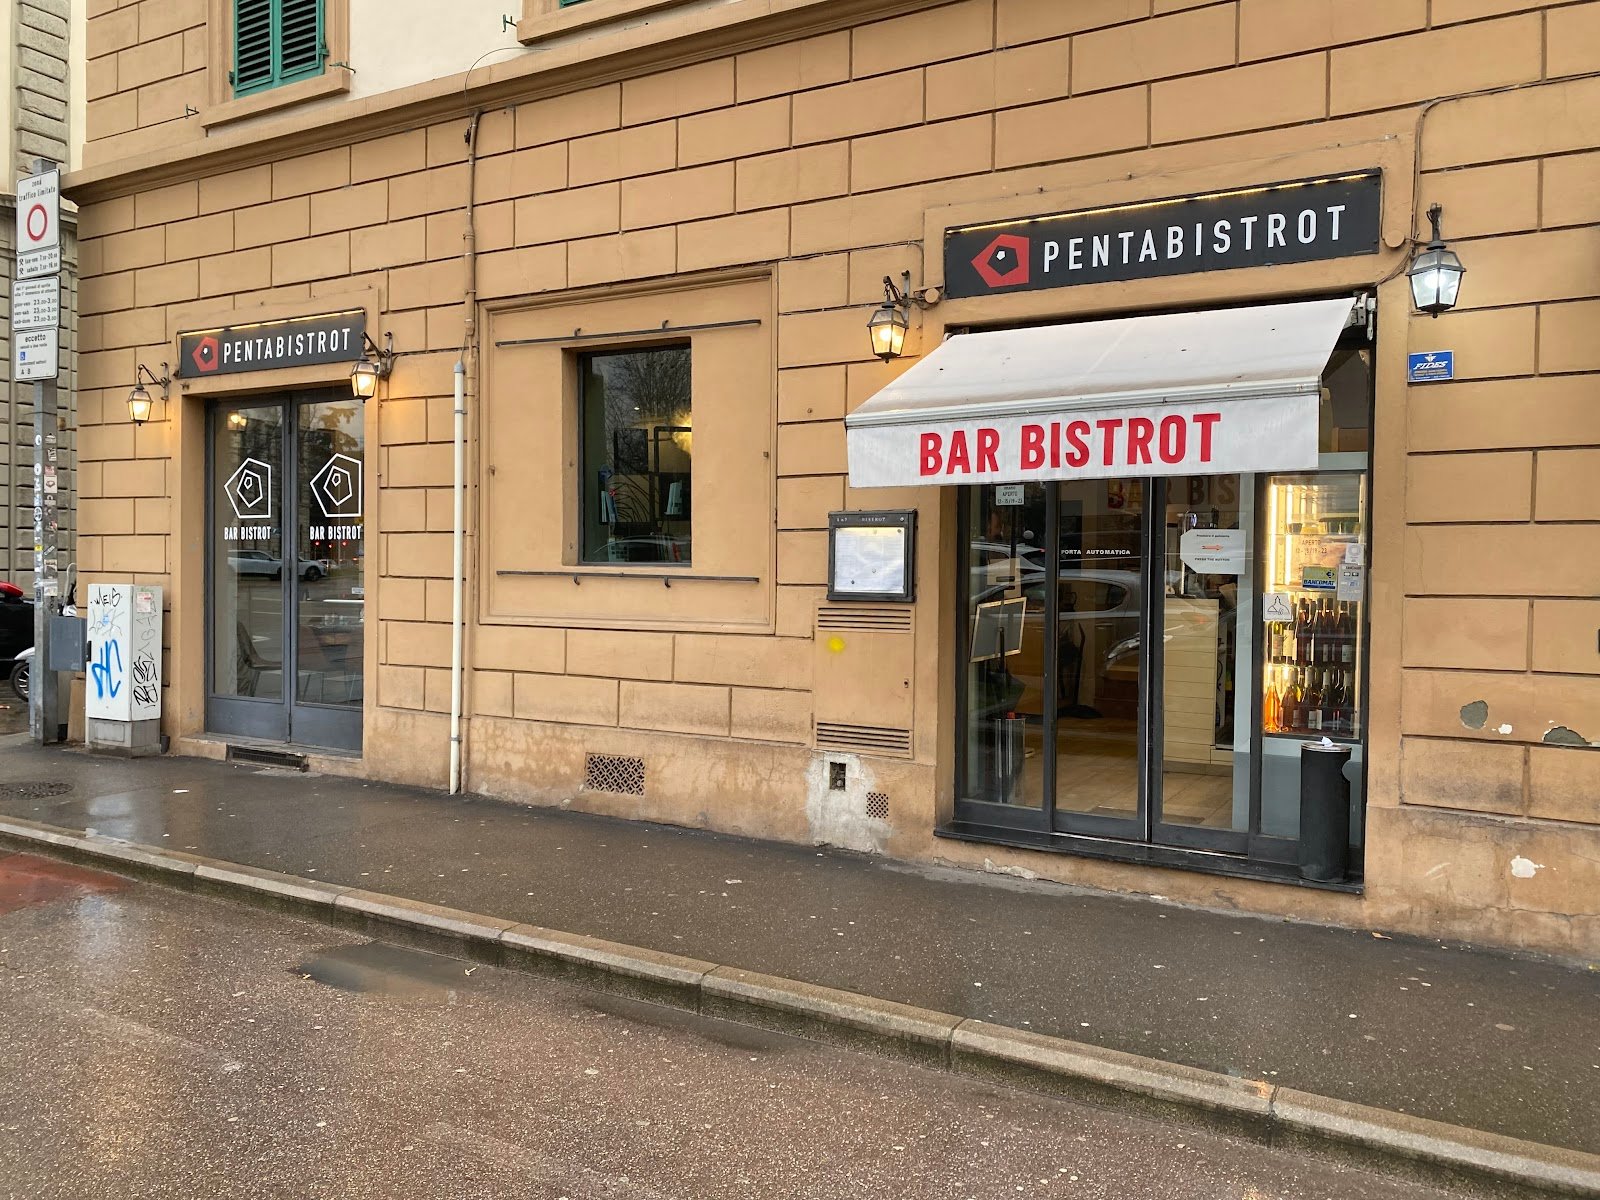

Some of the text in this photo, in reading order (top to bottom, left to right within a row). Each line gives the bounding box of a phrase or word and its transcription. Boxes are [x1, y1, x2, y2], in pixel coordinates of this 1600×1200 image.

[1043, 204, 1346, 273] PENTABISTROT
[25, 333, 46, 343] eccetto
[223, 328, 351, 364] PENTABISTROT
[1413, 361, 1449, 370] FIDES
[919, 412, 1221, 477] BAR BISTROT
[224, 526, 271, 540] BAR BISTROT
[309, 525, 361, 540] BAR BISTROT
